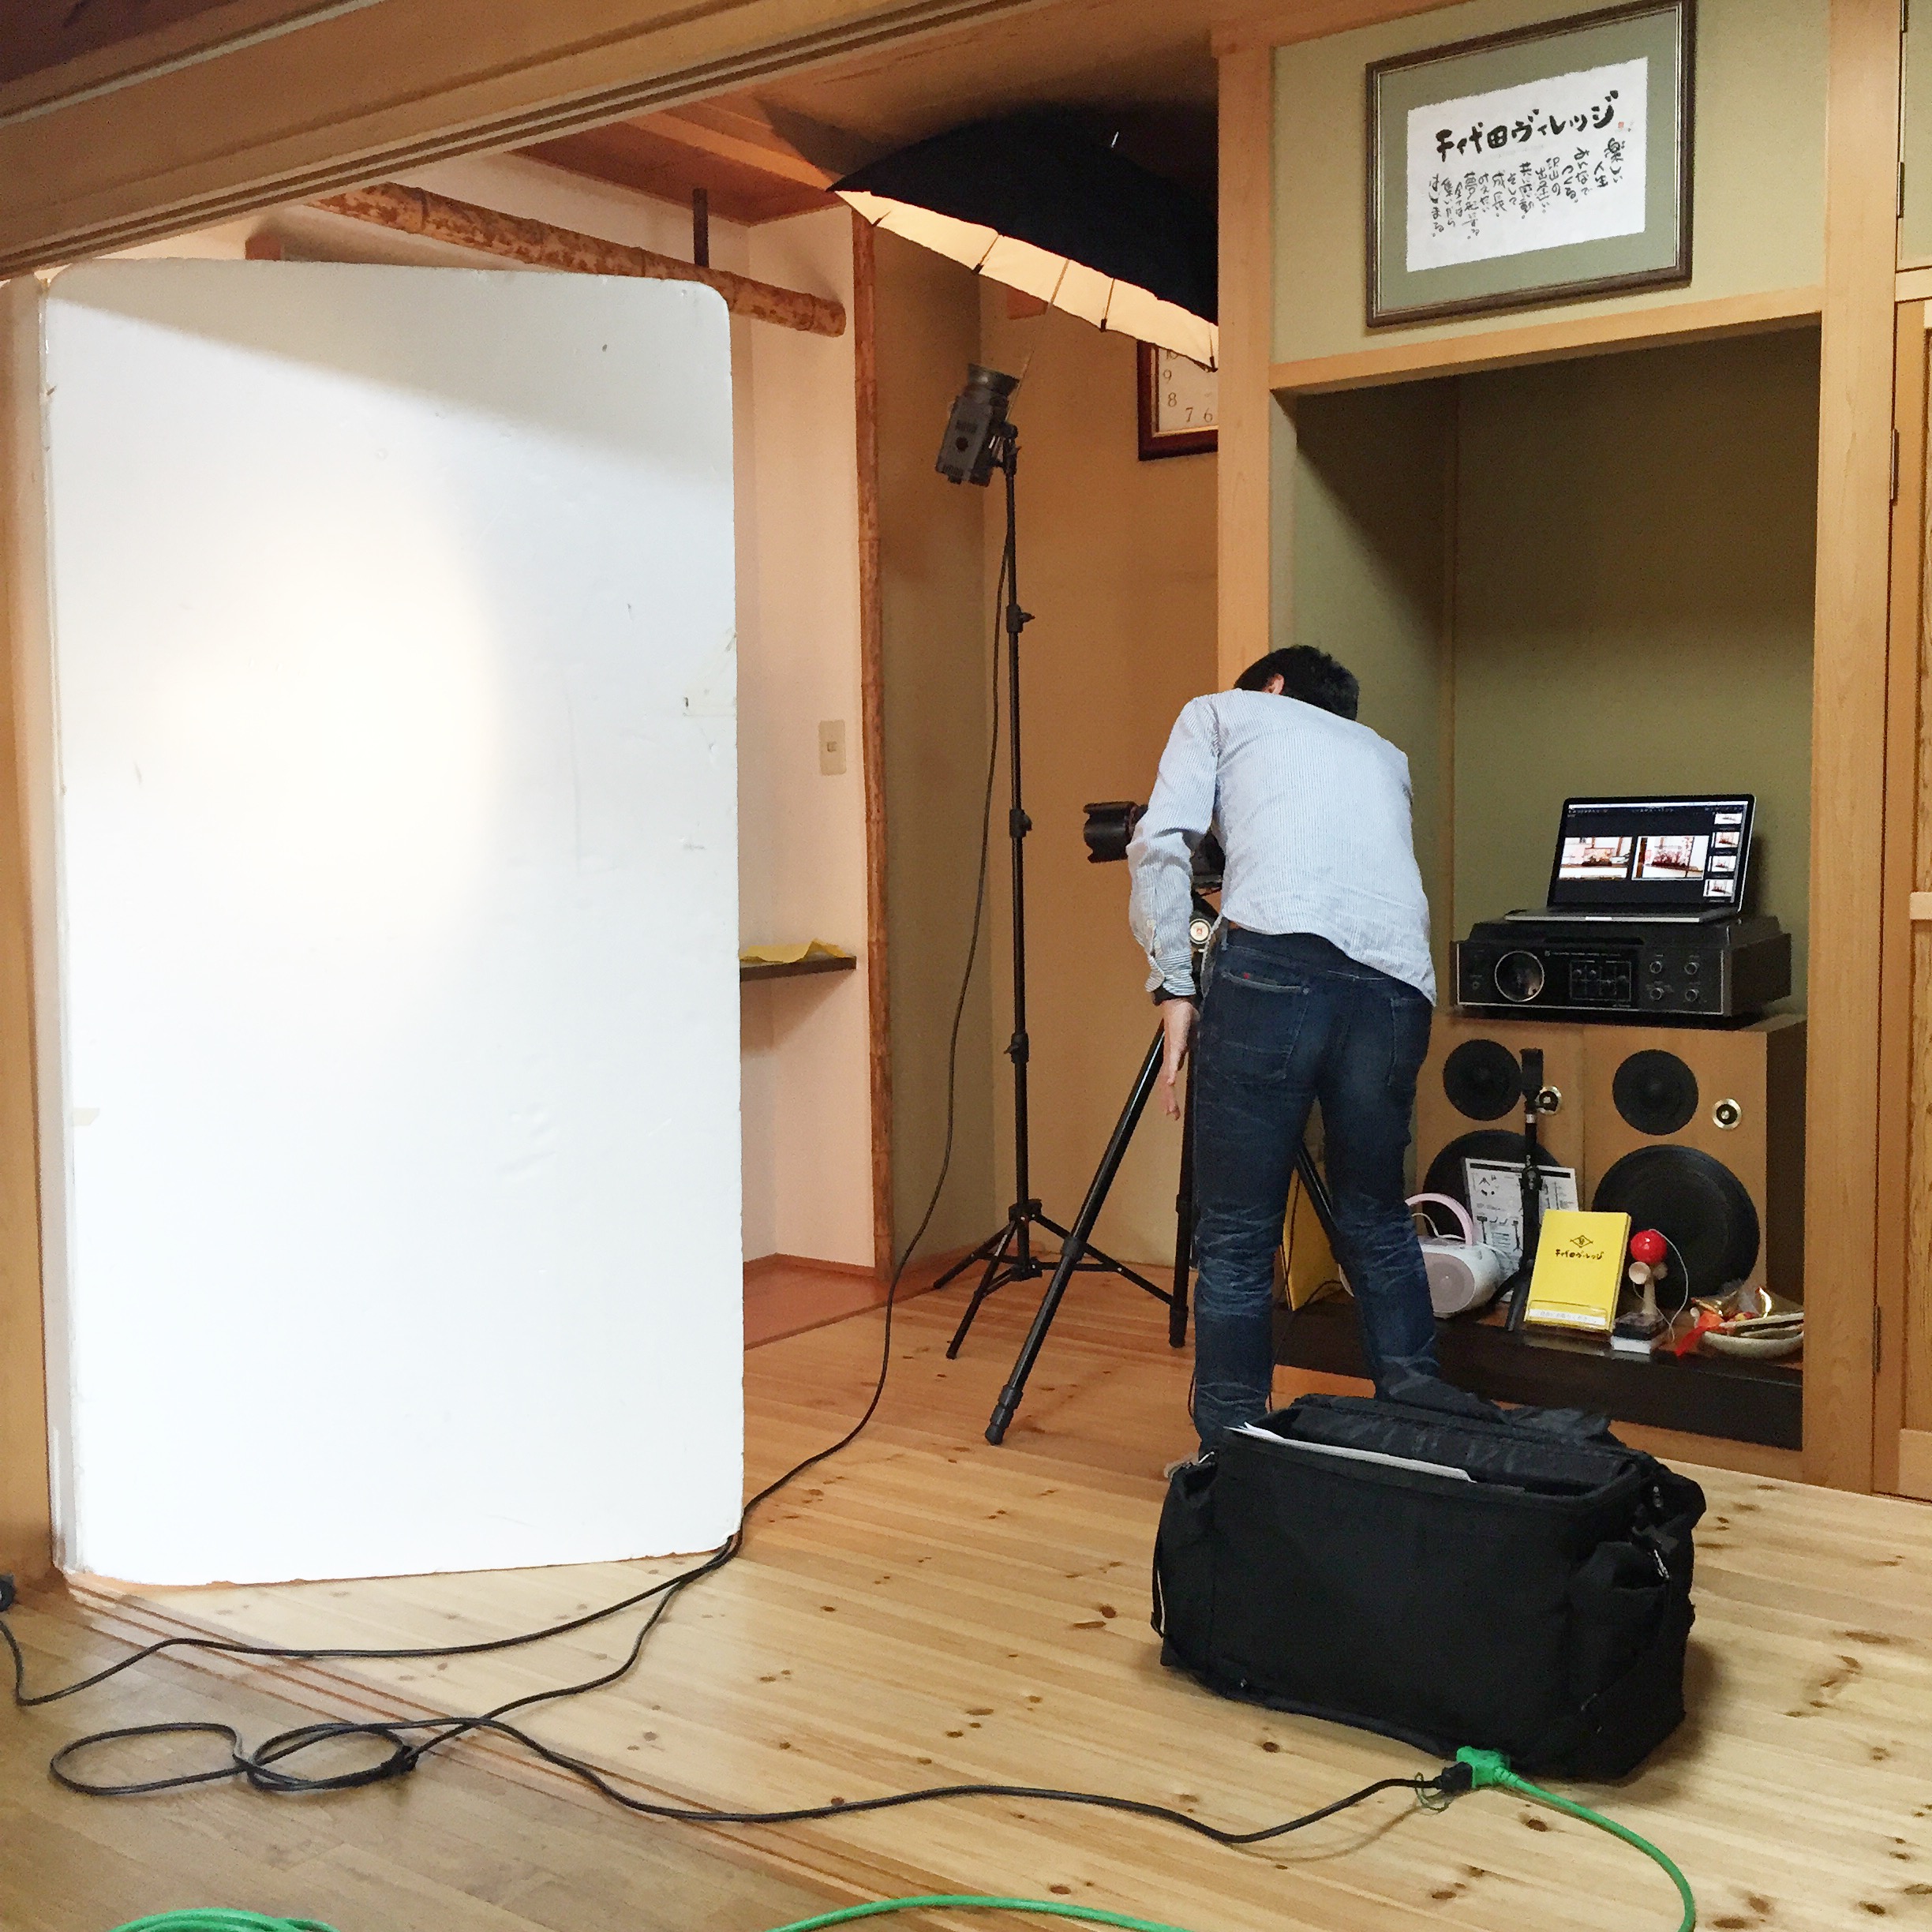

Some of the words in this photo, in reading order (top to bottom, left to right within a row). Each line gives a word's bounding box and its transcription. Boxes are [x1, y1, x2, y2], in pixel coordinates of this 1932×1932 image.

[1435, 89, 1619, 163] 千代田ヴィレッジ
[1545, 156, 1561, 197] 沢山の
[1574, 146, 1593, 196] みんなで
[1593, 160, 1608, 188] 人生
[1507, 172, 1518, 206] そして
[1163, 369, 1173, 384] 9
[1167, 391, 1178, 408] 8
[1185, 406, 1194, 423] 7
[1203, 407, 1214, 423] 6
